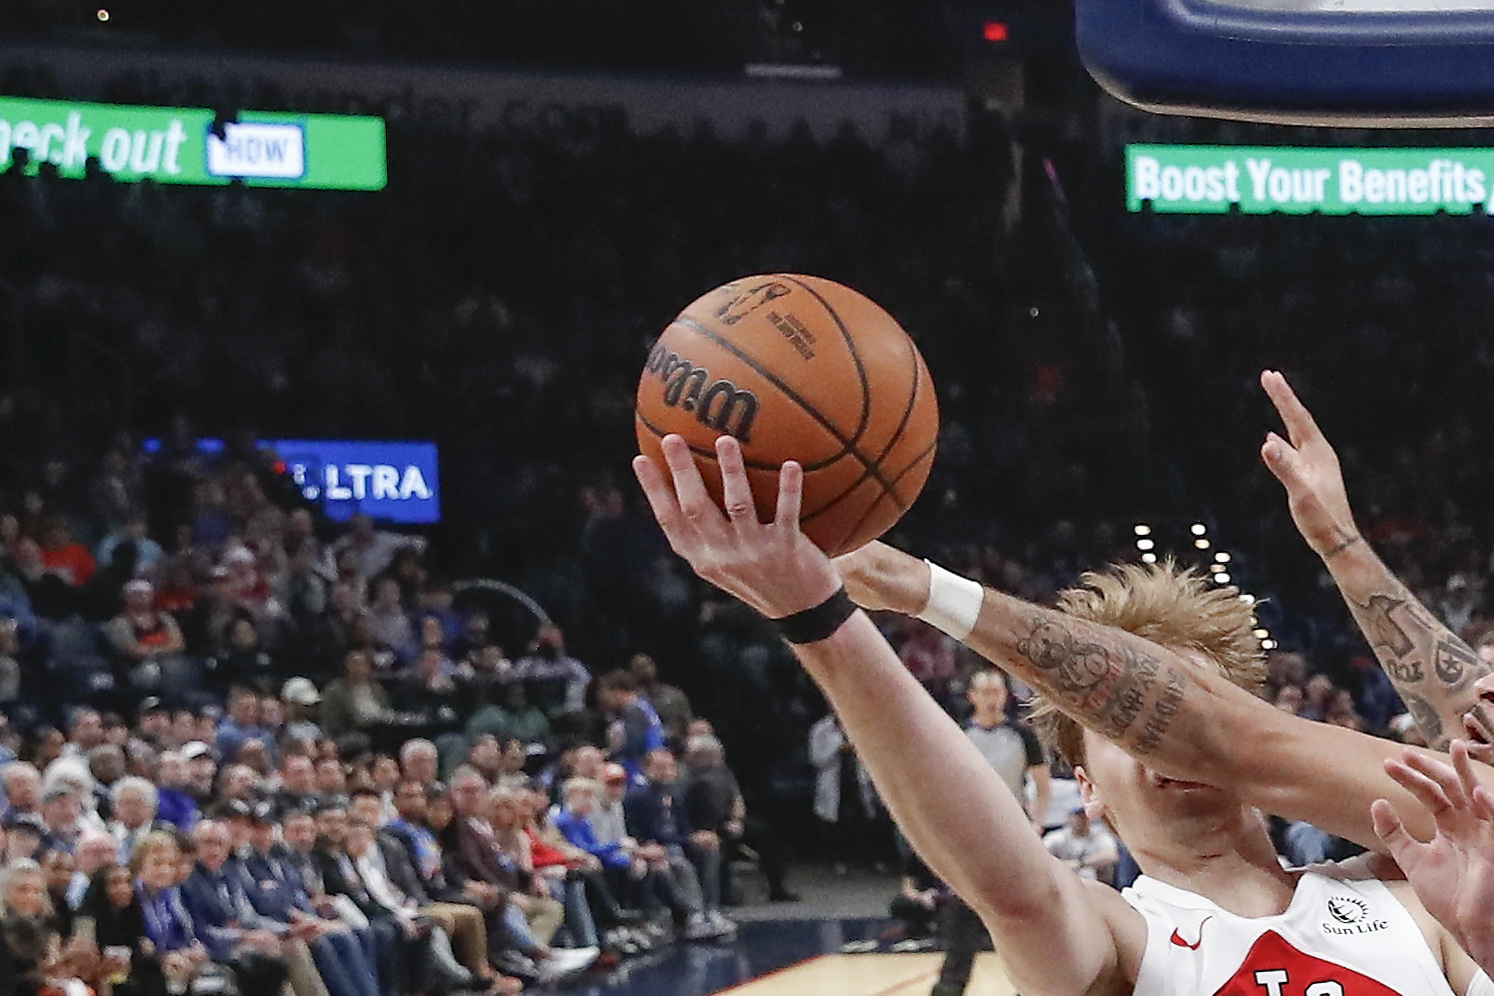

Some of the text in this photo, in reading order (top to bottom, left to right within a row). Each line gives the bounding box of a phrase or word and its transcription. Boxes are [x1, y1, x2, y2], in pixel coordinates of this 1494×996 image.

[101, 117, 187, 174] out
[1134, 154, 1487, 205] Boost Your Benefits
[1322, 919, 1389, 936] Sun Life
